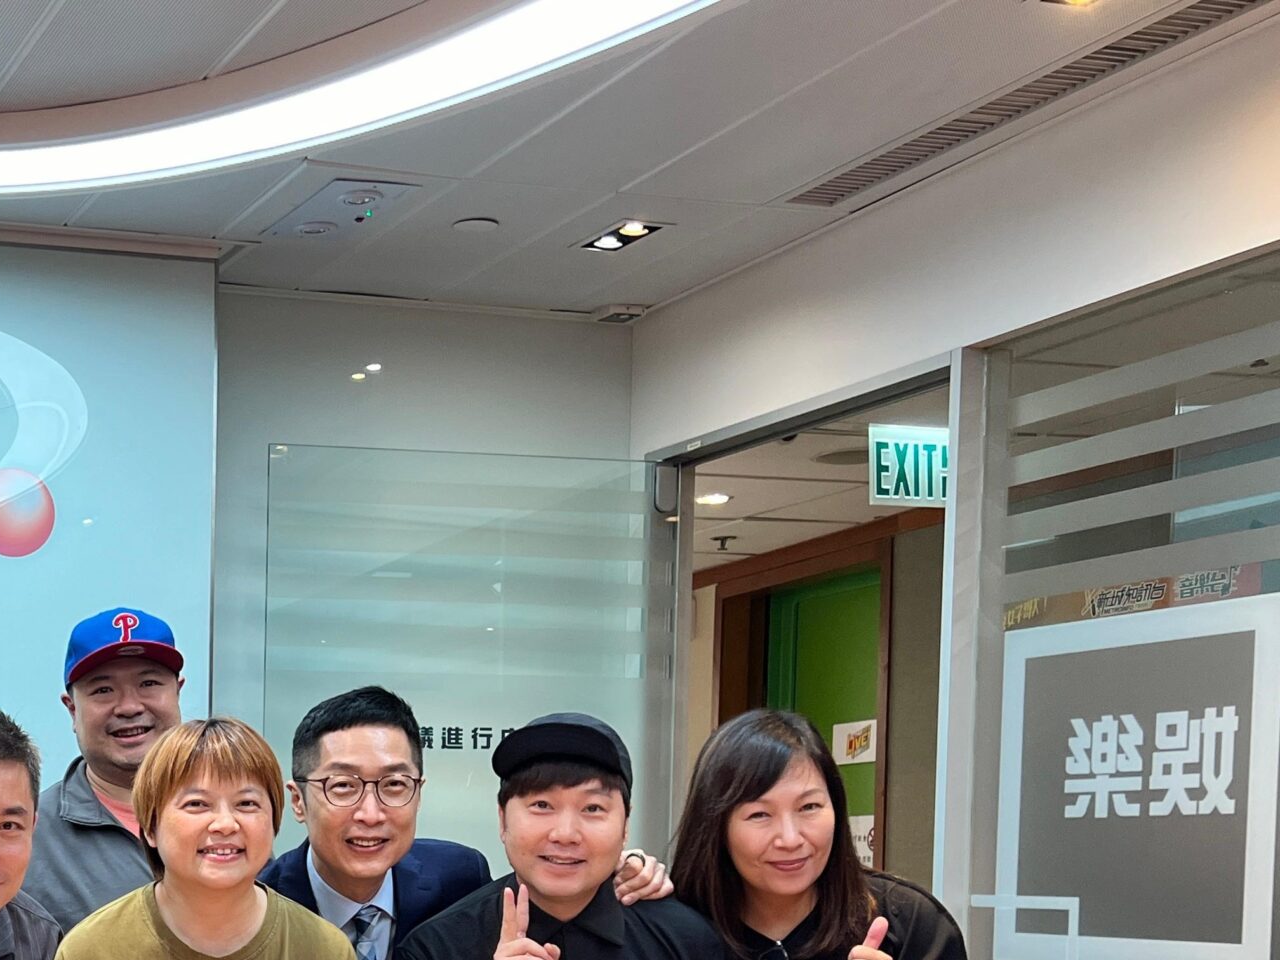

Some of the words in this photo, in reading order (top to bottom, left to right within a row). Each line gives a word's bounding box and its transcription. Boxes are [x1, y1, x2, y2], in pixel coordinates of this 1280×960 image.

[876, 441, 937, 498] EXIT
[112, 612, 139, 642] P
[419, 726, 517, 749] 議進行
